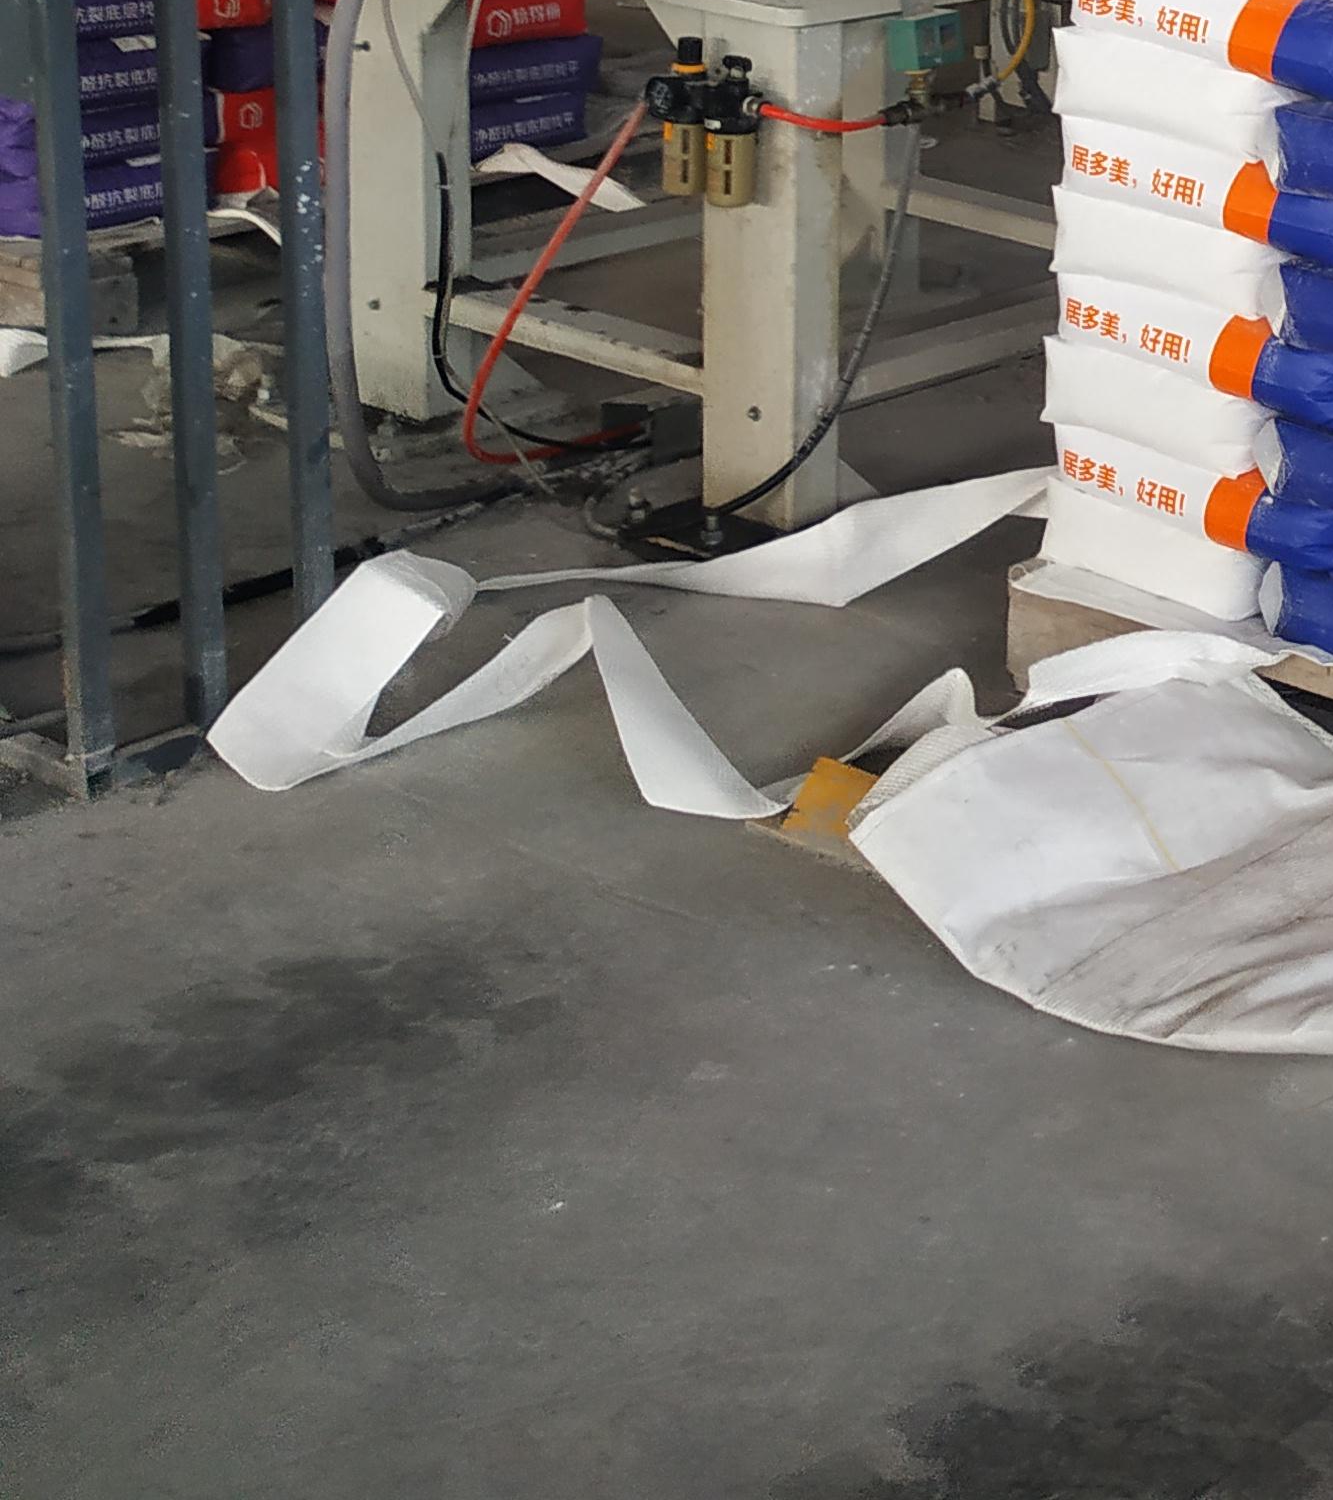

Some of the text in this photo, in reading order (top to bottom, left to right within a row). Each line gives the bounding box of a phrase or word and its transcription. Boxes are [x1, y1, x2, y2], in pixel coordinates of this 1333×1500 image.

[1072, 145, 1205, 206] 居多美，好用!
[1066, 298, 1192, 362] 居多美，好用!
[1063, 450, 1187, 516] 居多美，好用!
